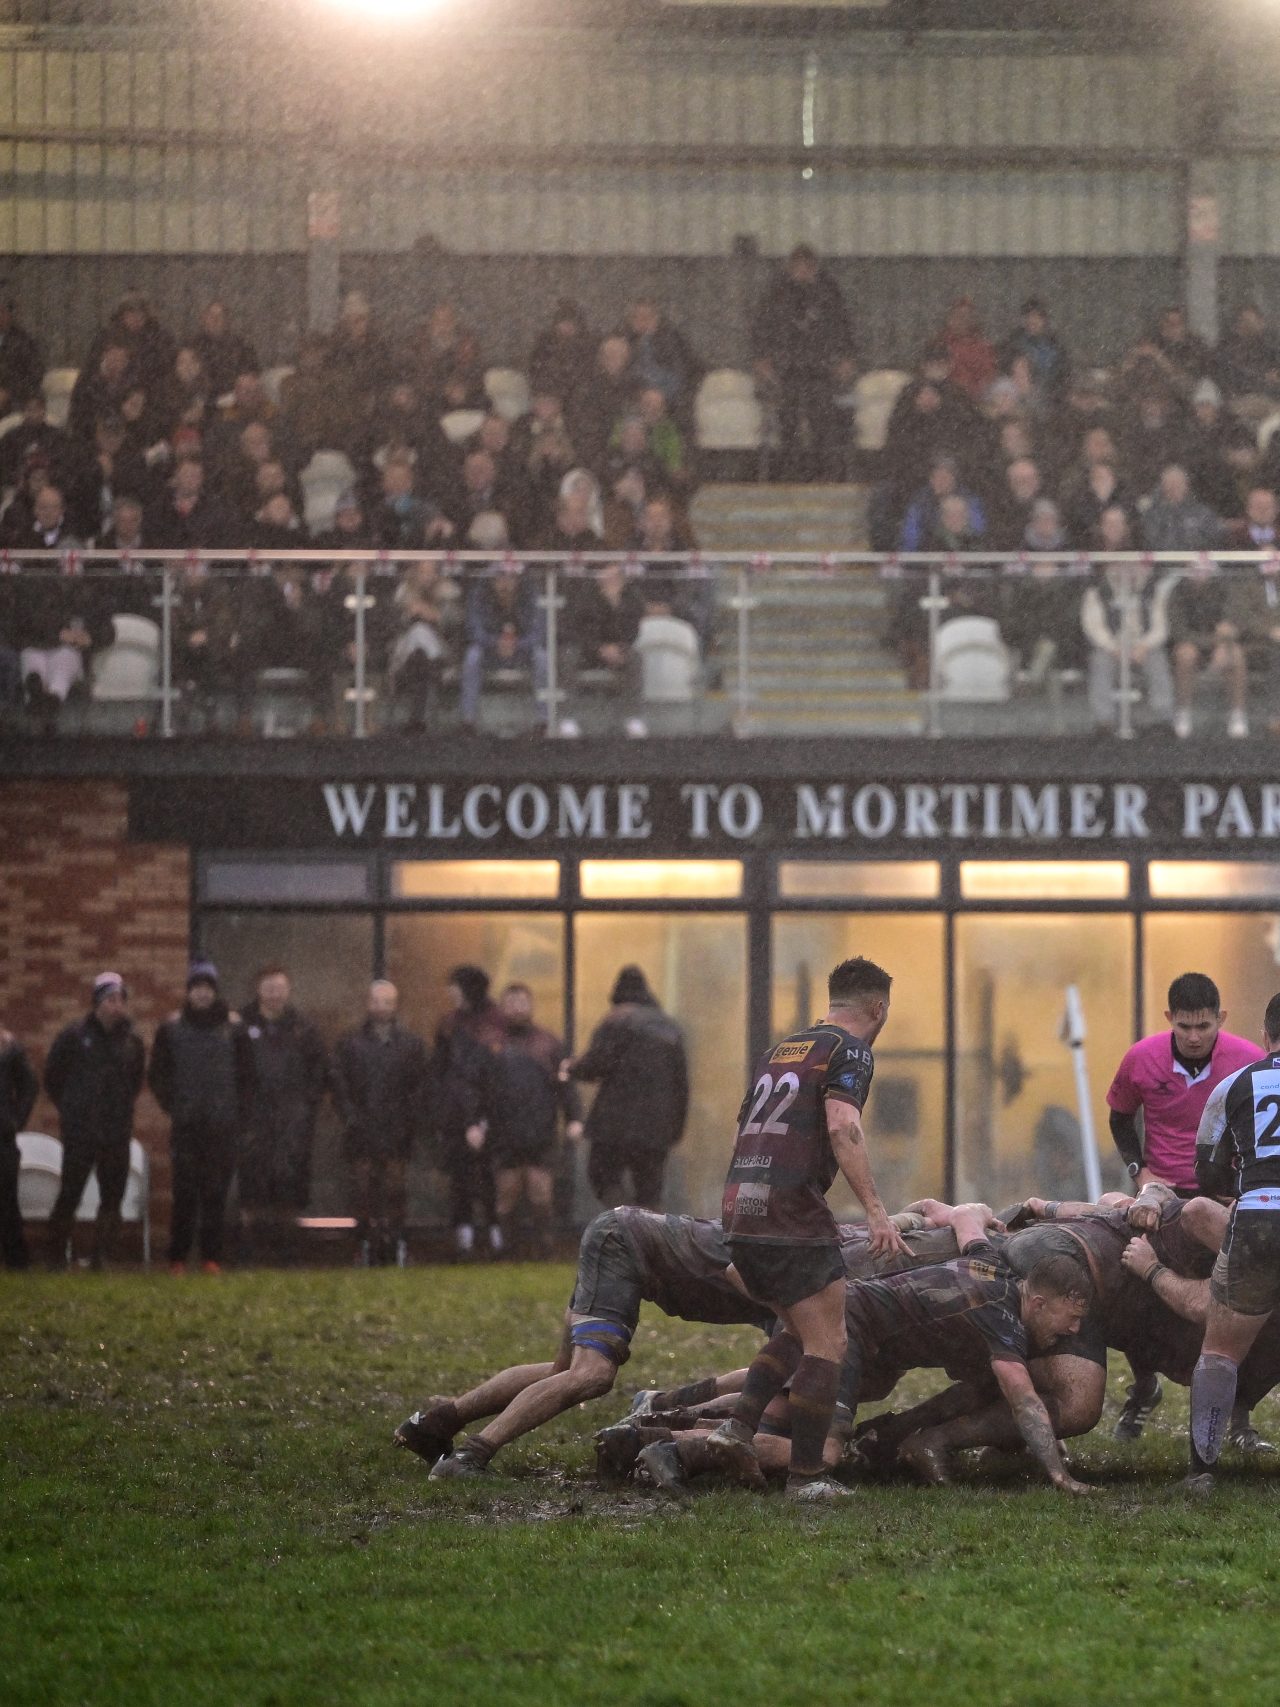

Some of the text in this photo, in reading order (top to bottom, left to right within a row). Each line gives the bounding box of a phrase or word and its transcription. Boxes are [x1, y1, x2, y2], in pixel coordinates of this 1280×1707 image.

[322, 783, 652, 839] WELCOME
[680, 783, 763, 839] TO
[796, 782, 1150, 838] MORTIMER
[740, 1071, 800, 1137] 22
